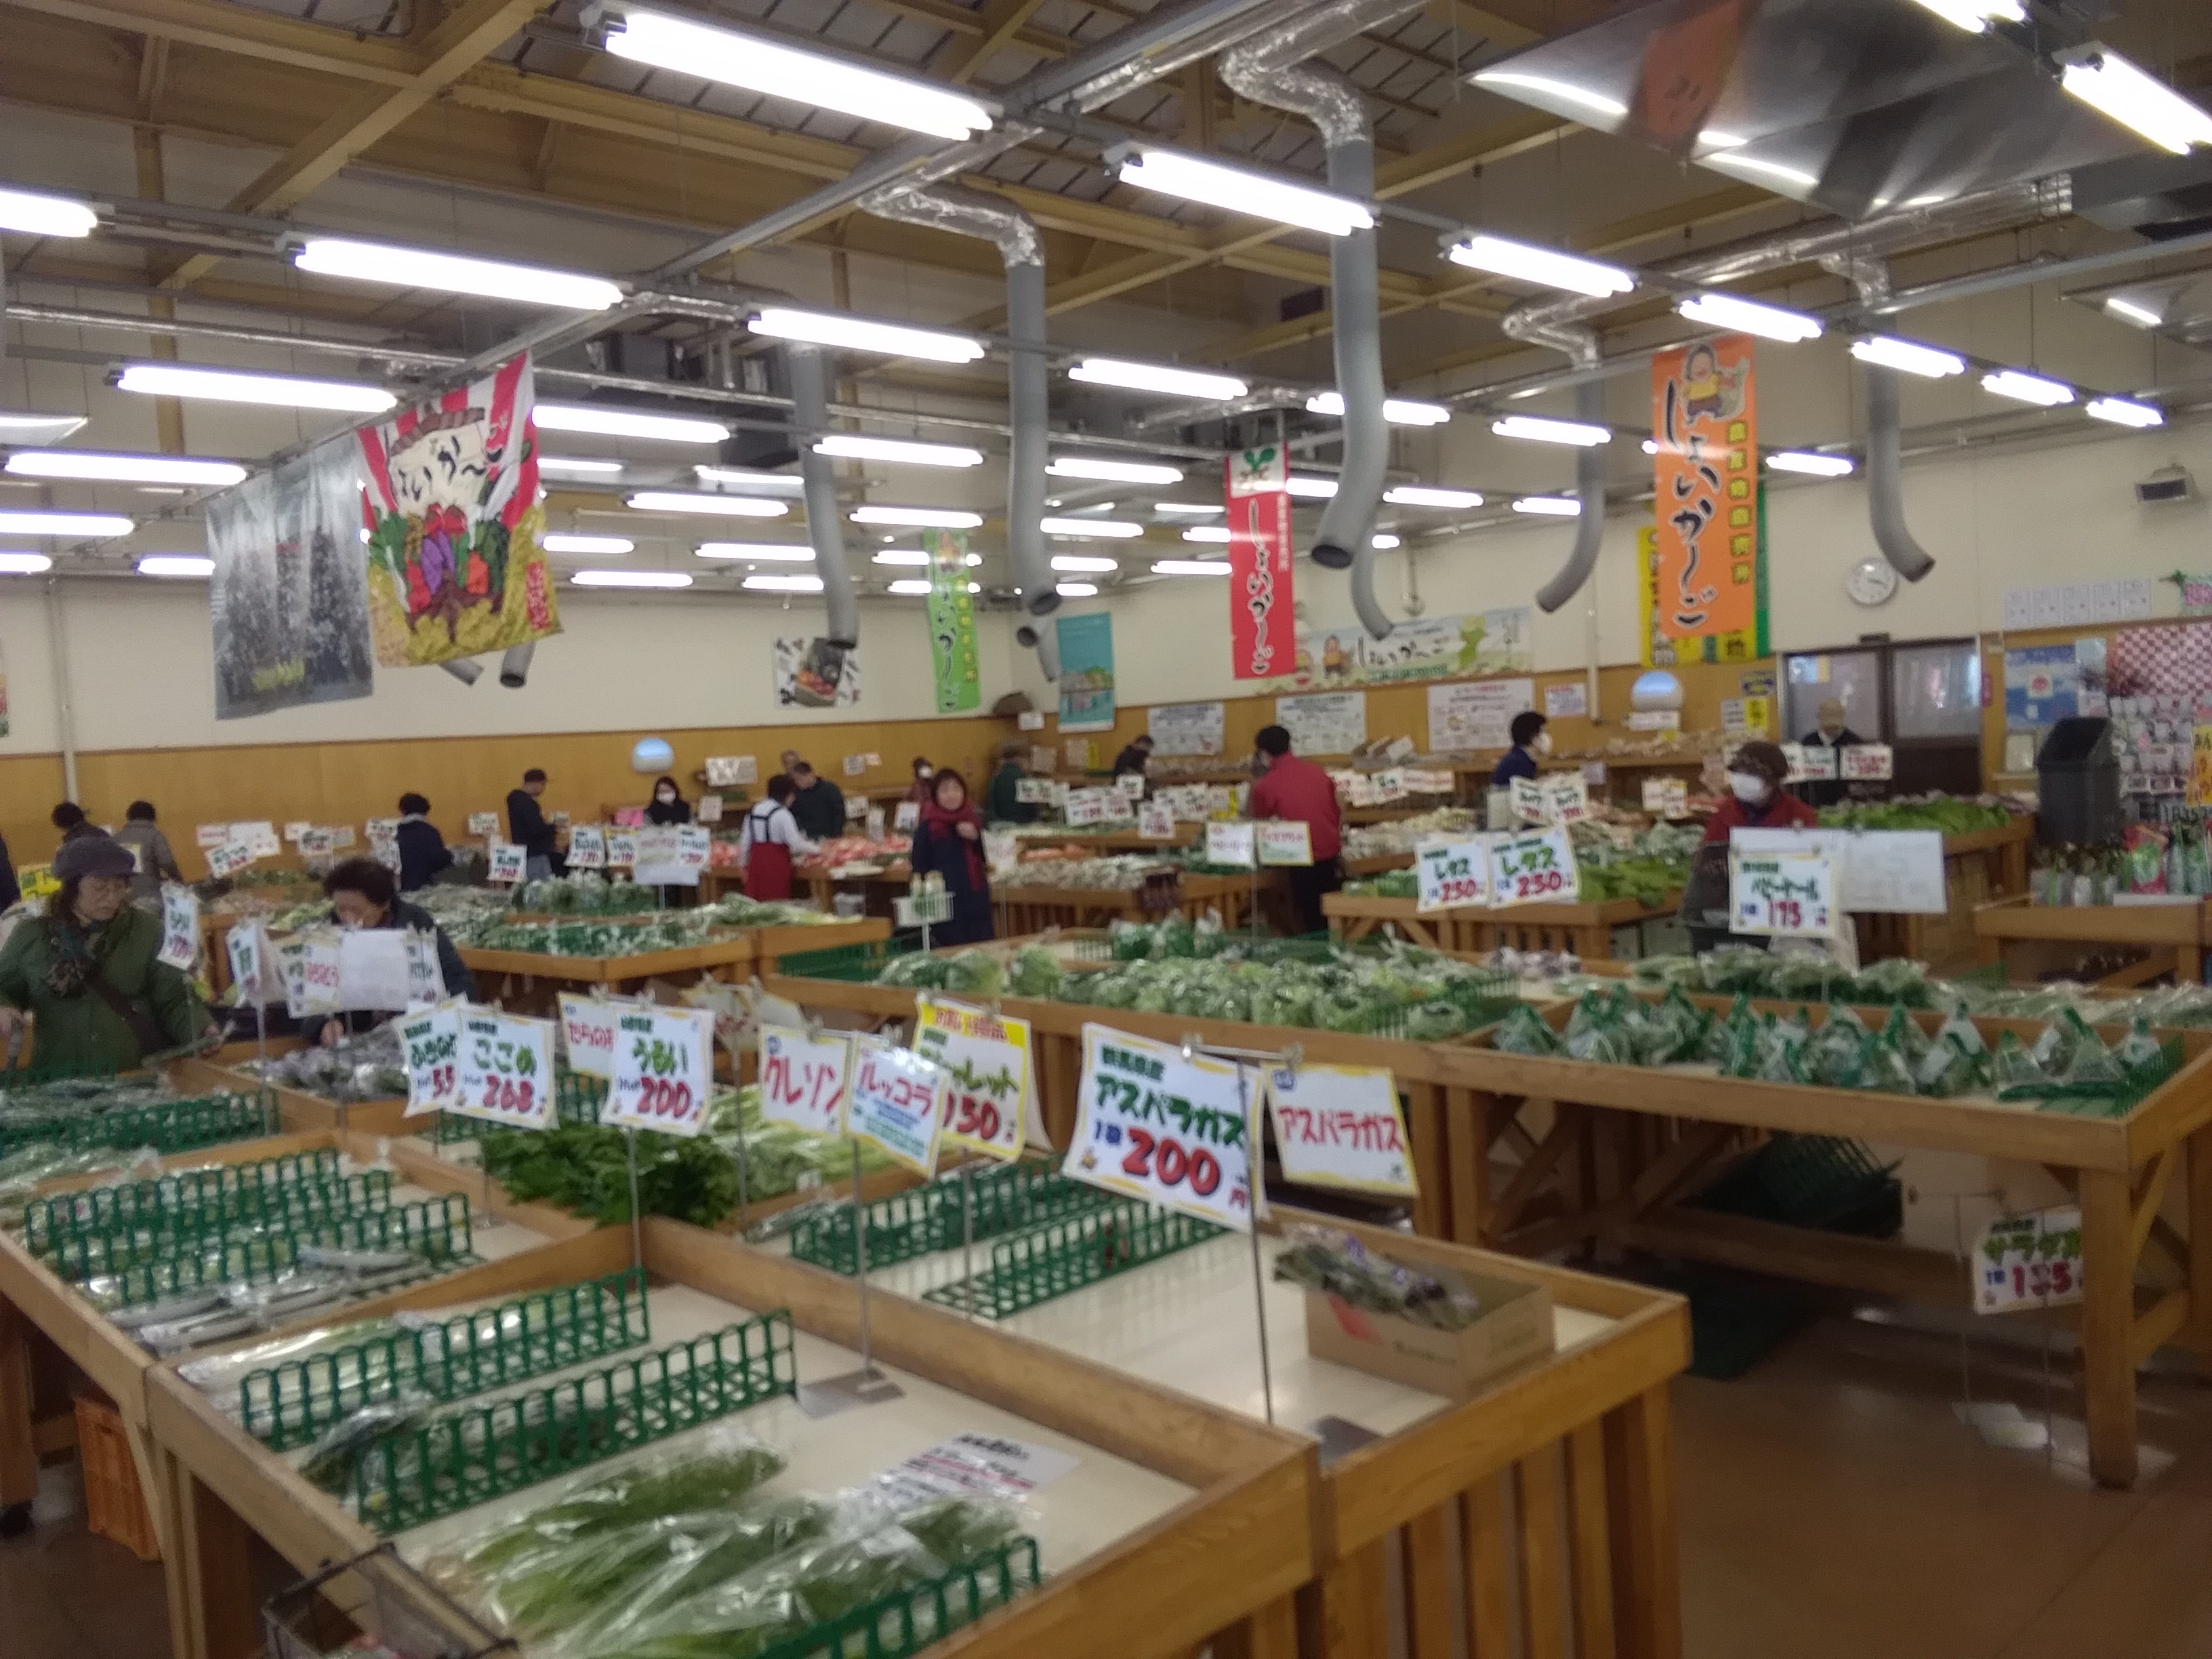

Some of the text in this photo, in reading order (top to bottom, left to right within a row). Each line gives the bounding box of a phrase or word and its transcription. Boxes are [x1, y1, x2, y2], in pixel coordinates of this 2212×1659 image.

[1518, 871, 1561, 897] 250
[636, 1075, 691, 1118] 200
[860, 1061, 933, 1117] ルッコラ
[1095, 1073, 1246, 1147] アスパラガス
[1279, 1106, 1404, 1153] アスパラガス
[1122, 1126, 1221, 1196] 200
